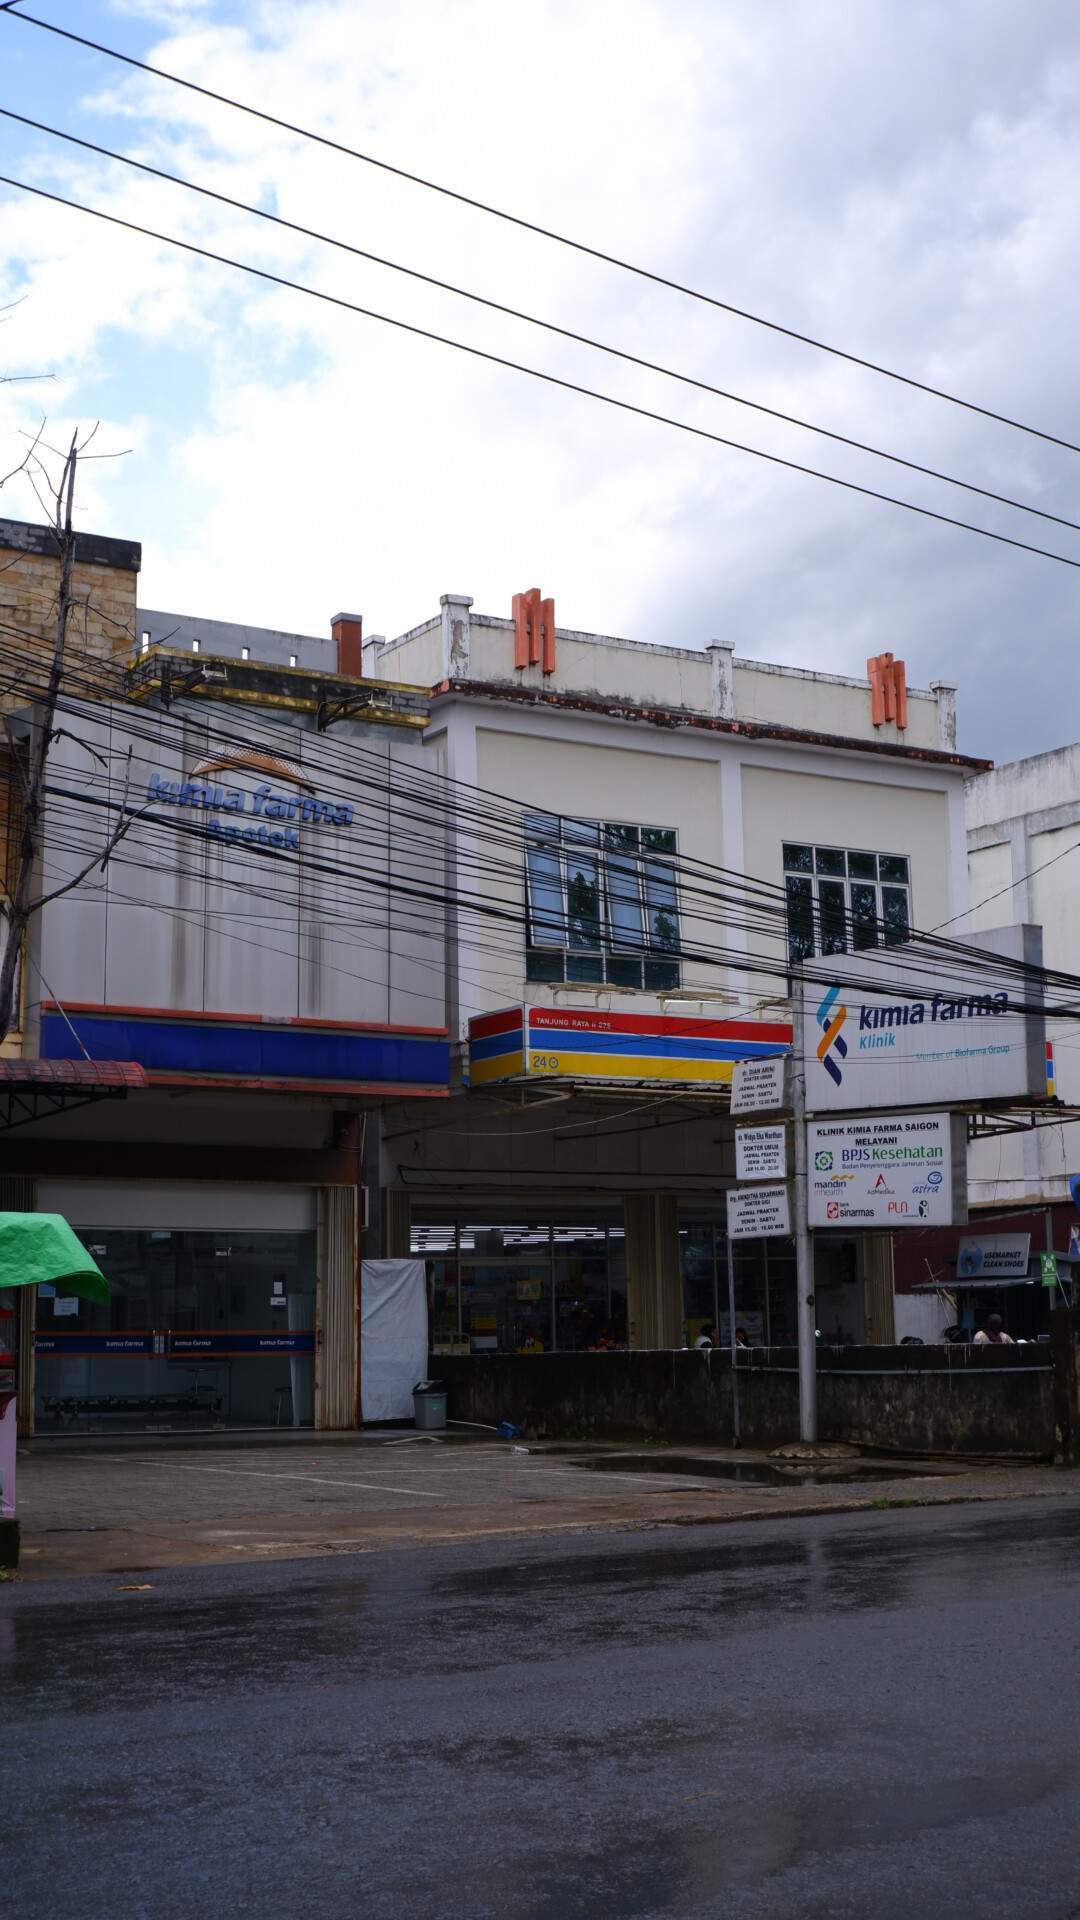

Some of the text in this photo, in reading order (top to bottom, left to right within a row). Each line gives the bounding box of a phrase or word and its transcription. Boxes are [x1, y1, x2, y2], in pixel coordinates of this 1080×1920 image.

[147, 773, 354, 826] kimia farma
[208, 819, 300, 848] Apotek
[859, 992, 1009, 1031] kimia farma
[536, 1017, 569, 1026] TANJUNG
[572, 1019, 589, 1027] RAYA
[859, 1032, 896, 1049] Klinik
[988, 1044, 1010, 1055] Group
[533, 1056, 547, 1068] 24
[817, 1122, 939, 1136] KLINIK KIMIA FARMA SAIGON
[855, 1137, 897, 1146] MELAYANI
[842, 1146, 943, 1162] BPJS Kesehatan
[912, 1184, 940, 1194] astra
[840, 1207, 875, 1217] sinarmas
[888, 1201, 908, 1214] PLN
[1004, 1260, 1024, 1268] SHOES
